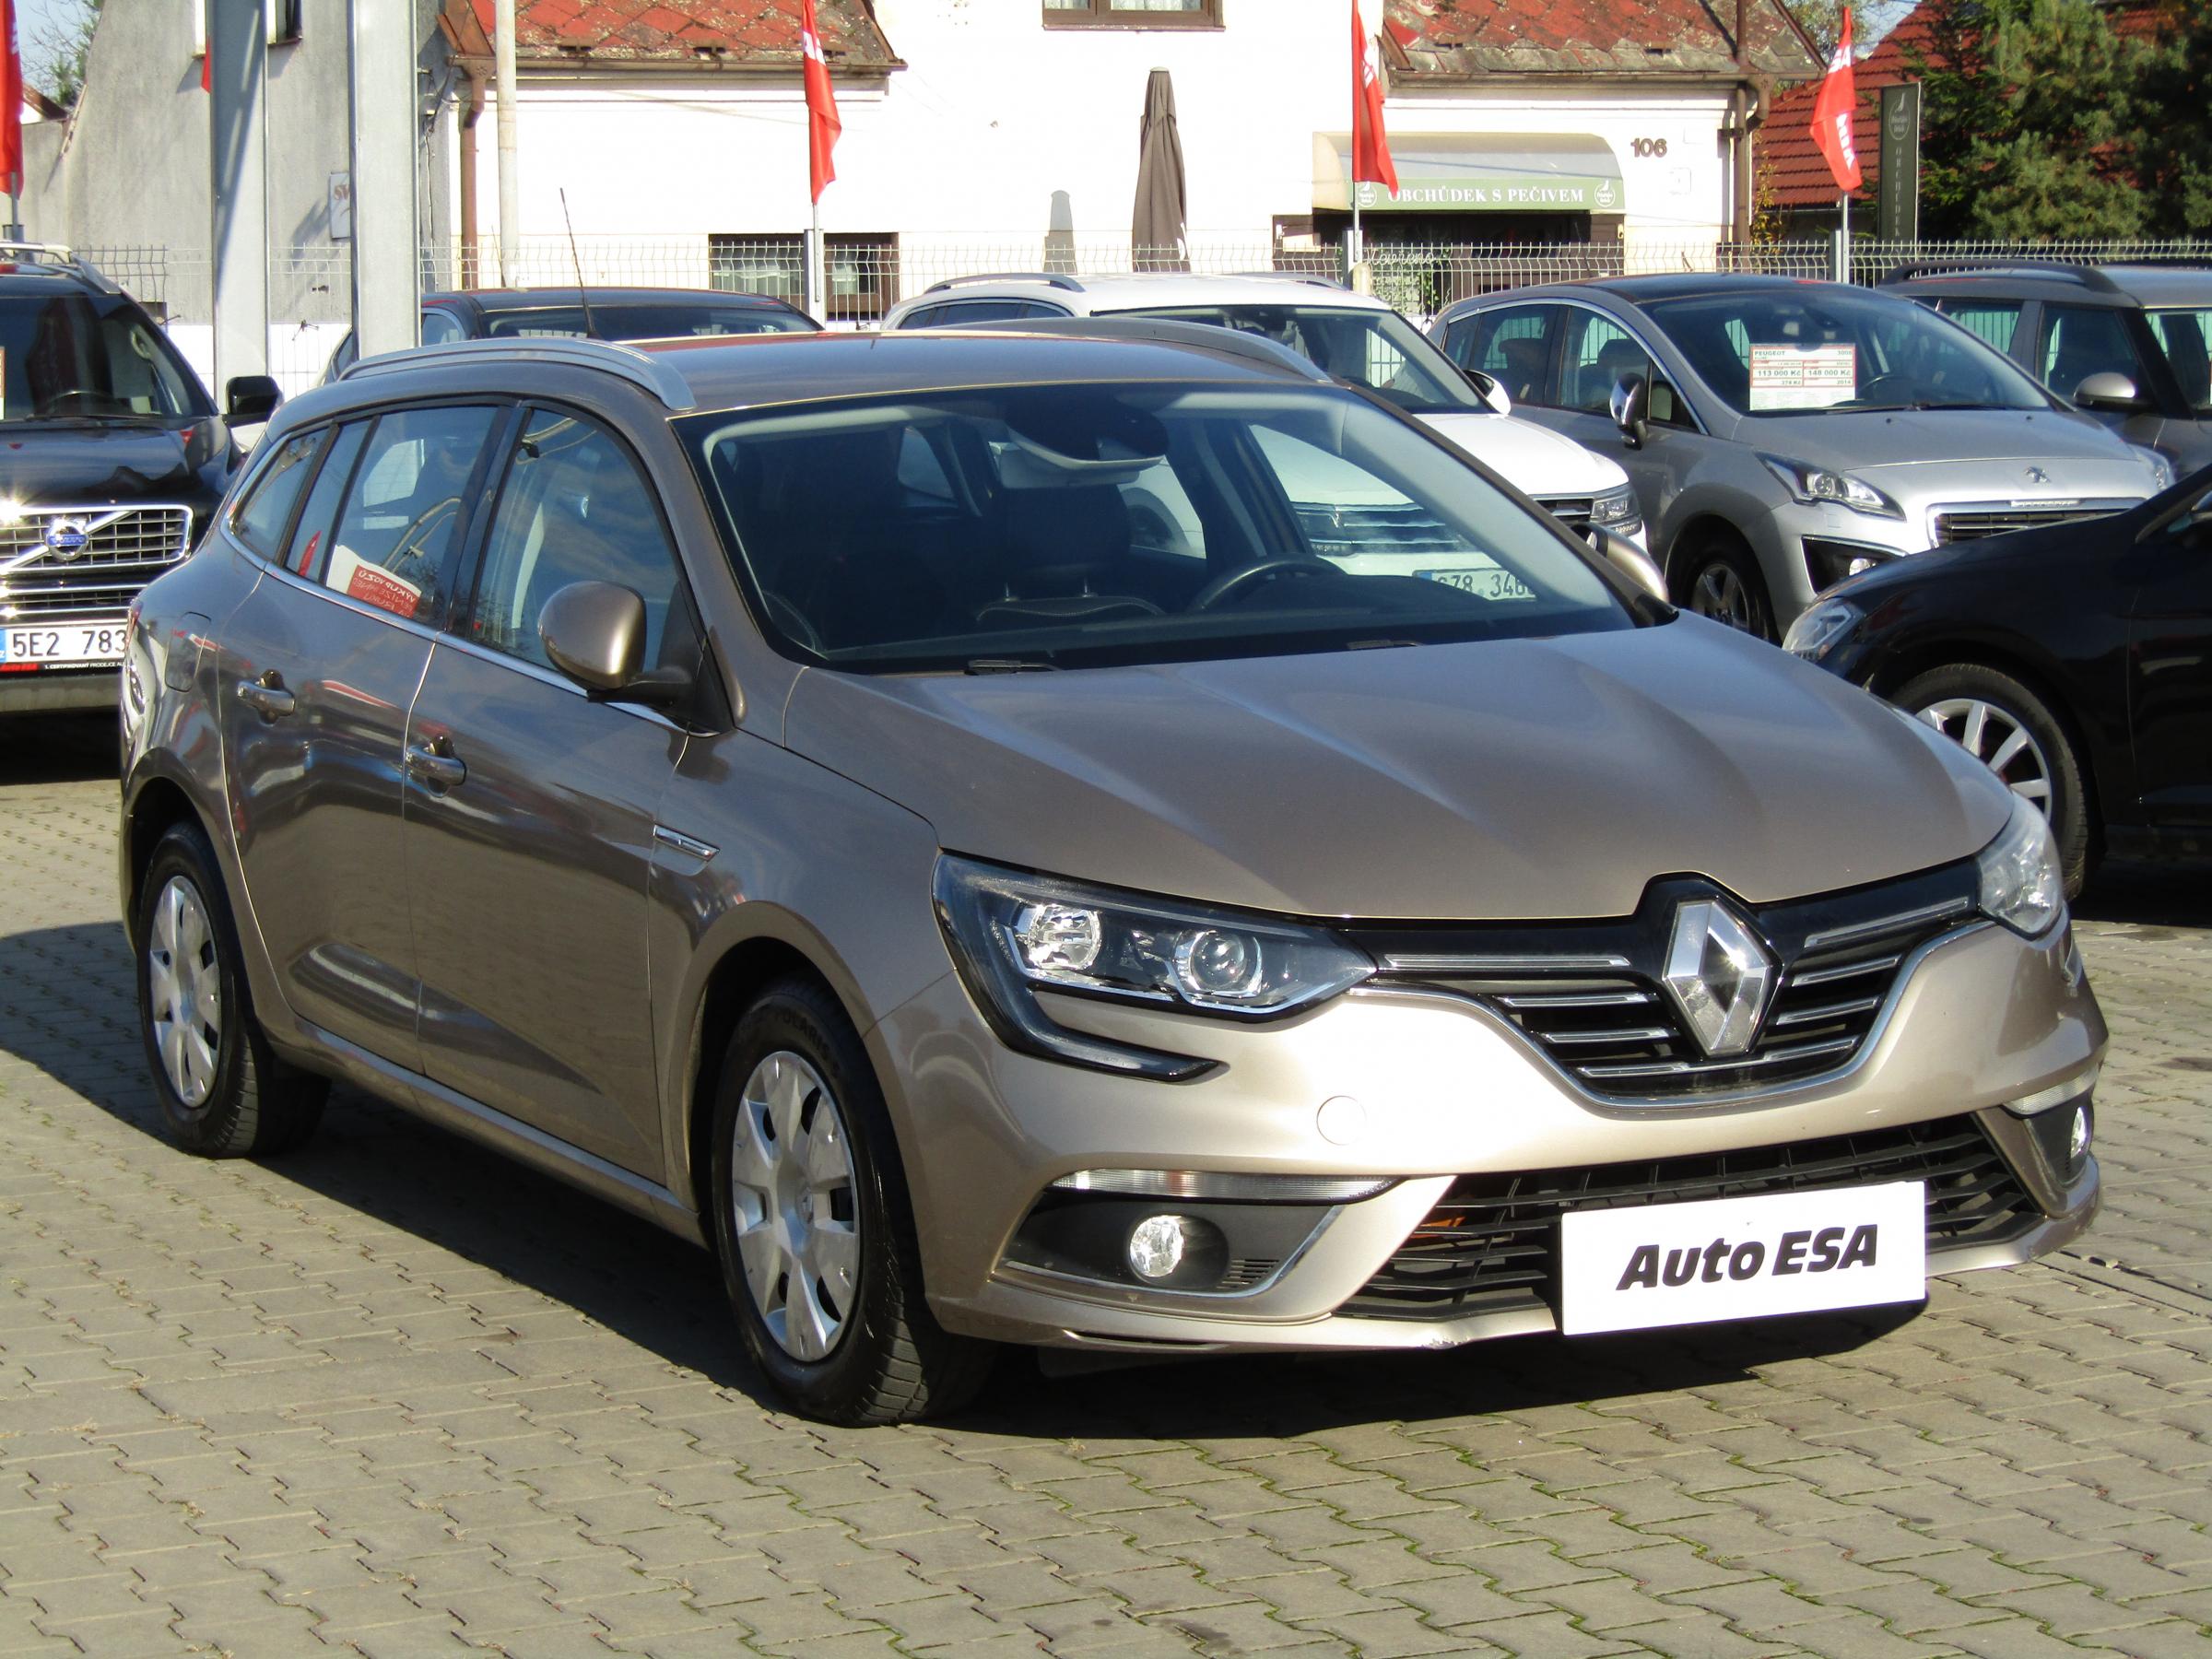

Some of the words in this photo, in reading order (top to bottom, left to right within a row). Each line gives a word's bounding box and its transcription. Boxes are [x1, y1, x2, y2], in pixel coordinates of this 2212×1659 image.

[1630, 138, 1667, 158] 106
[1388, 185, 1487, 203] OBCHŮDEK
[1492, 188, 1501, 202] S
[1508, 186, 1583, 203] PEČIVEM
[12, 631, 60, 657] 5E2
[1617, 1238, 1765, 1290] Auto
[1772, 1224, 1877, 1277] ESA
